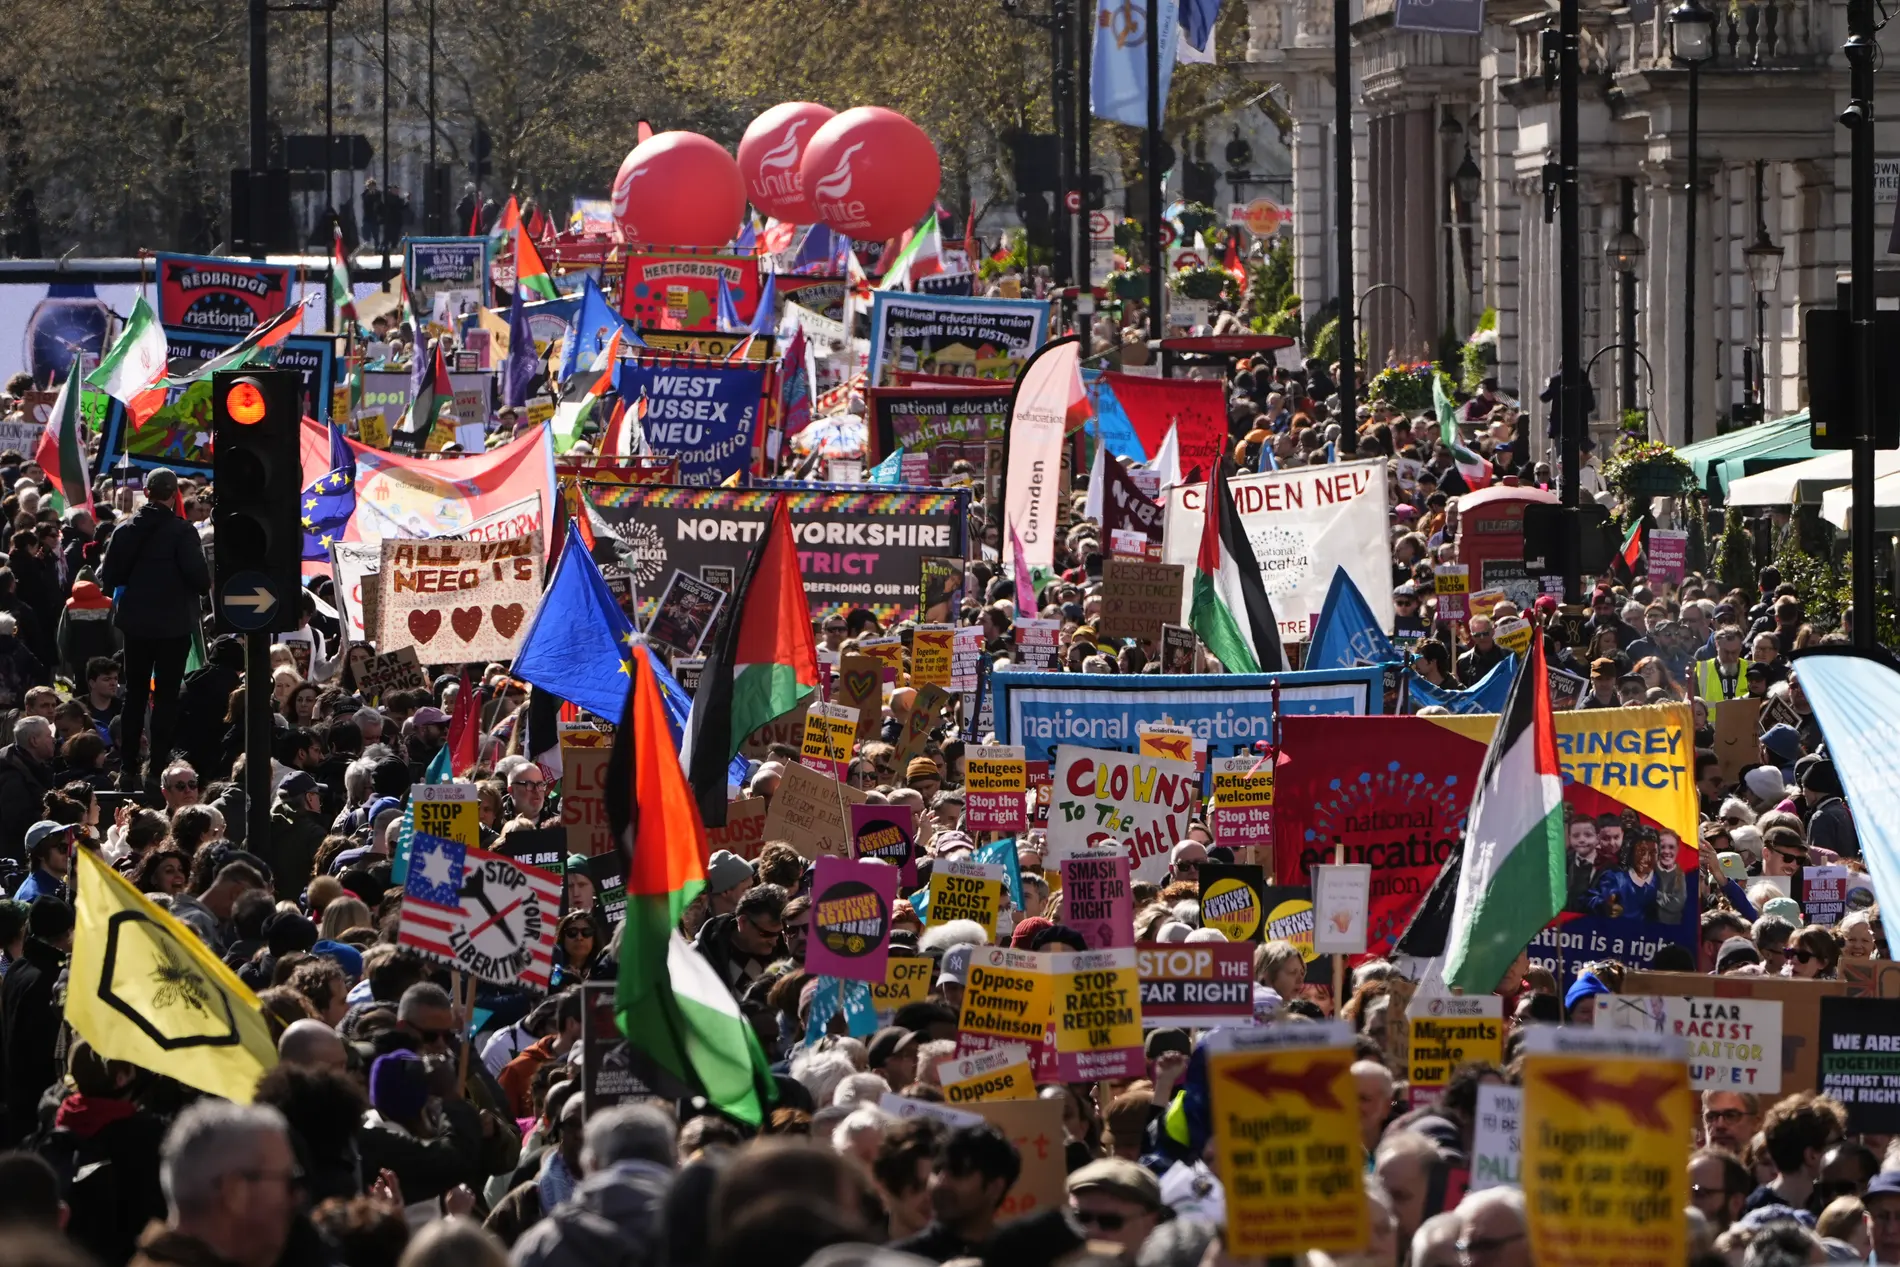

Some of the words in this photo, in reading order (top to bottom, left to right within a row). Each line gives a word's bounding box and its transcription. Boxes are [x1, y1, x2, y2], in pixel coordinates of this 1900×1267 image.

[181, 271, 268, 295] REDBRIDGE
[187, 309, 255, 328] national
[891, 307, 937, 323] national
[939, 311, 996, 327] education
[999, 316, 1031, 328] union
[946, 326, 975, 338] EAST
[978, 328, 1029, 348] DISTRICT
[652, 375, 721, 399] WEST
[650, 401, 729, 423] USSEX
[890, 400, 947, 415] national
[1017, 411, 1064, 425] education
[651, 422, 703, 444] NEU
[900, 418, 980, 449] WALTHAM
[1024, 460, 1044, 544] Camden
[1182, 476, 1303, 516] CDEN
[1315, 470, 1370, 507] NEU
[791, 521, 951, 548] YORKSHIRE
[394, 544, 460, 568] ALL
[1257, 546, 1296, 557] national
[1650, 550, 1683, 560] Refugees
[1110, 564, 1171, 580] RESPECT
[1650, 559, 1681, 568] welcome
[394, 568, 480, 594] NEED
[491, 558, 532, 583] IS
[678, 581, 700, 596] NEEDS
[700, 590, 714, 601] YOU
[803, 582, 868, 595] DEFENDING
[873, 584, 900, 596] OUR
[1104, 582, 1177, 598] EXISTENCE
[1438, 583, 1465, 593] RACISM
[1105, 600, 1122, 613] OR
[1129, 602, 1177, 615] EXPECT
[1440, 610, 1465, 620] TRUMP
[916, 647, 940, 657] Together
[925, 657, 934, 665] can
[364, 652, 399, 674] FAR
[915, 664, 924, 673] the
[925, 664, 934, 673] far
[935, 663, 948, 674] right
[808, 716, 854, 735] Migrants
[1024, 708, 1128, 739] national
[804, 744, 822, 755] our
[1556, 728, 1682, 757] RINGEY
[968, 761, 1023, 777] Refugees
[1563, 762, 1686, 792] STRICT
[789, 774, 818, 797] DEATH
[968, 777, 1021, 789] welcome
[1067, 758, 1193, 815] CLOWNS
[1216, 775, 1273, 790] Refugees
[969, 794, 996, 810] Stop
[998, 794, 1019, 807] the
[1217, 789, 1272, 803] welcome
[420, 803, 462, 820] STOP
[969, 809, 987, 822] far
[989, 809, 1019, 824] right
[1094, 802, 1133, 833] The
[1217, 810, 1246, 826] Stop
[1249, 809, 1270, 822] the
[1344, 805, 1434, 832] national
[421, 821, 452, 838] THE
[1218, 824, 1238, 838] far
[1240, 823, 1270, 839] right
[514, 854, 533, 864] WE
[535, 852, 560, 863] ARE
[1071, 851, 1096, 860] Socialist
[1097, 850, 1117, 858] Worker
[484, 861, 528, 890] STOP
[1068, 861, 1117, 881] SMASH
[602, 875, 621, 890] WE
[945, 876, 985, 894] STOP
[1068, 881, 1096, 900] THE
[1100, 880, 1124, 899] FAR
[1826, 879, 1838, 890] THE
[818, 894, 877, 913] EDUCATORS
[937, 892, 991, 910] RACIST
[1205, 887, 1249, 907] EDUCATORS
[1808, 889, 1840, 901] STRUGGLES
[523, 891, 542, 941] YOUR
[817, 903, 879, 927] AGAINST
[932, 905, 992, 925] REFORM
[1070, 900, 1113, 920] RIGHT
[1204, 892, 1251, 920] AGAINST
[1805, 903, 1819, 914] FIGHT
[1820, 902, 1843, 914] RACISM
[841, 920, 858, 935] FAR
[858, 917, 882, 937] RIGHT
[1590, 929, 1607, 953] is
[1612, 934, 1625, 954] a
[1006, 953, 1026, 961] STAND
[1014, 961, 1038, 969] RACISM
[1138, 950, 1212, 977] STOP
[1219, 960, 1249, 977] THE
[893, 964, 927, 981] OFF
[970, 967, 1034, 992] Oppose
[1073, 972, 1118, 992] STOP
[1065, 989, 1128, 1011] RACIST
[1139, 984, 1175, 1003] FAR
[1183, 982, 1249, 1003] RIGHT
[968, 989, 1029, 1017] Tommy
[1690, 1002, 1740, 1021] LIAR
[963, 1010, 1042, 1036] Robinson
[1063, 1008, 1133, 1030] REFORM
[961, 1033, 986, 1047] Stop
[1088, 1029, 1111, 1047] UK
[1414, 1021, 1497, 1045] Migrants
[1673, 1019, 1754, 1041] RACIST
[1832, 1034, 1861, 1050] WE
[1076, 1050, 1127, 1067] Refugees
[1413, 1045, 1464, 1062] make
[1078, 1065, 1127, 1078] welcome
[1413, 1067, 1445, 1081] our
[1824, 1074, 1878, 1088] AGAINST
[949, 1073, 1014, 1101] Oppose
[1228, 1111, 1313, 1142] Together
[1538, 1125, 1632, 1156] Together
[1264, 1145, 1296, 1166] can
[1305, 1140, 1348, 1171] stop
[1232, 1174, 1262, 1197] the
[1270, 1172, 1298, 1197] far
[1305, 1168, 1354, 1200] right
[1619, 1160, 1672, 1189] stop
[1621, 1193, 1675, 1224] right
